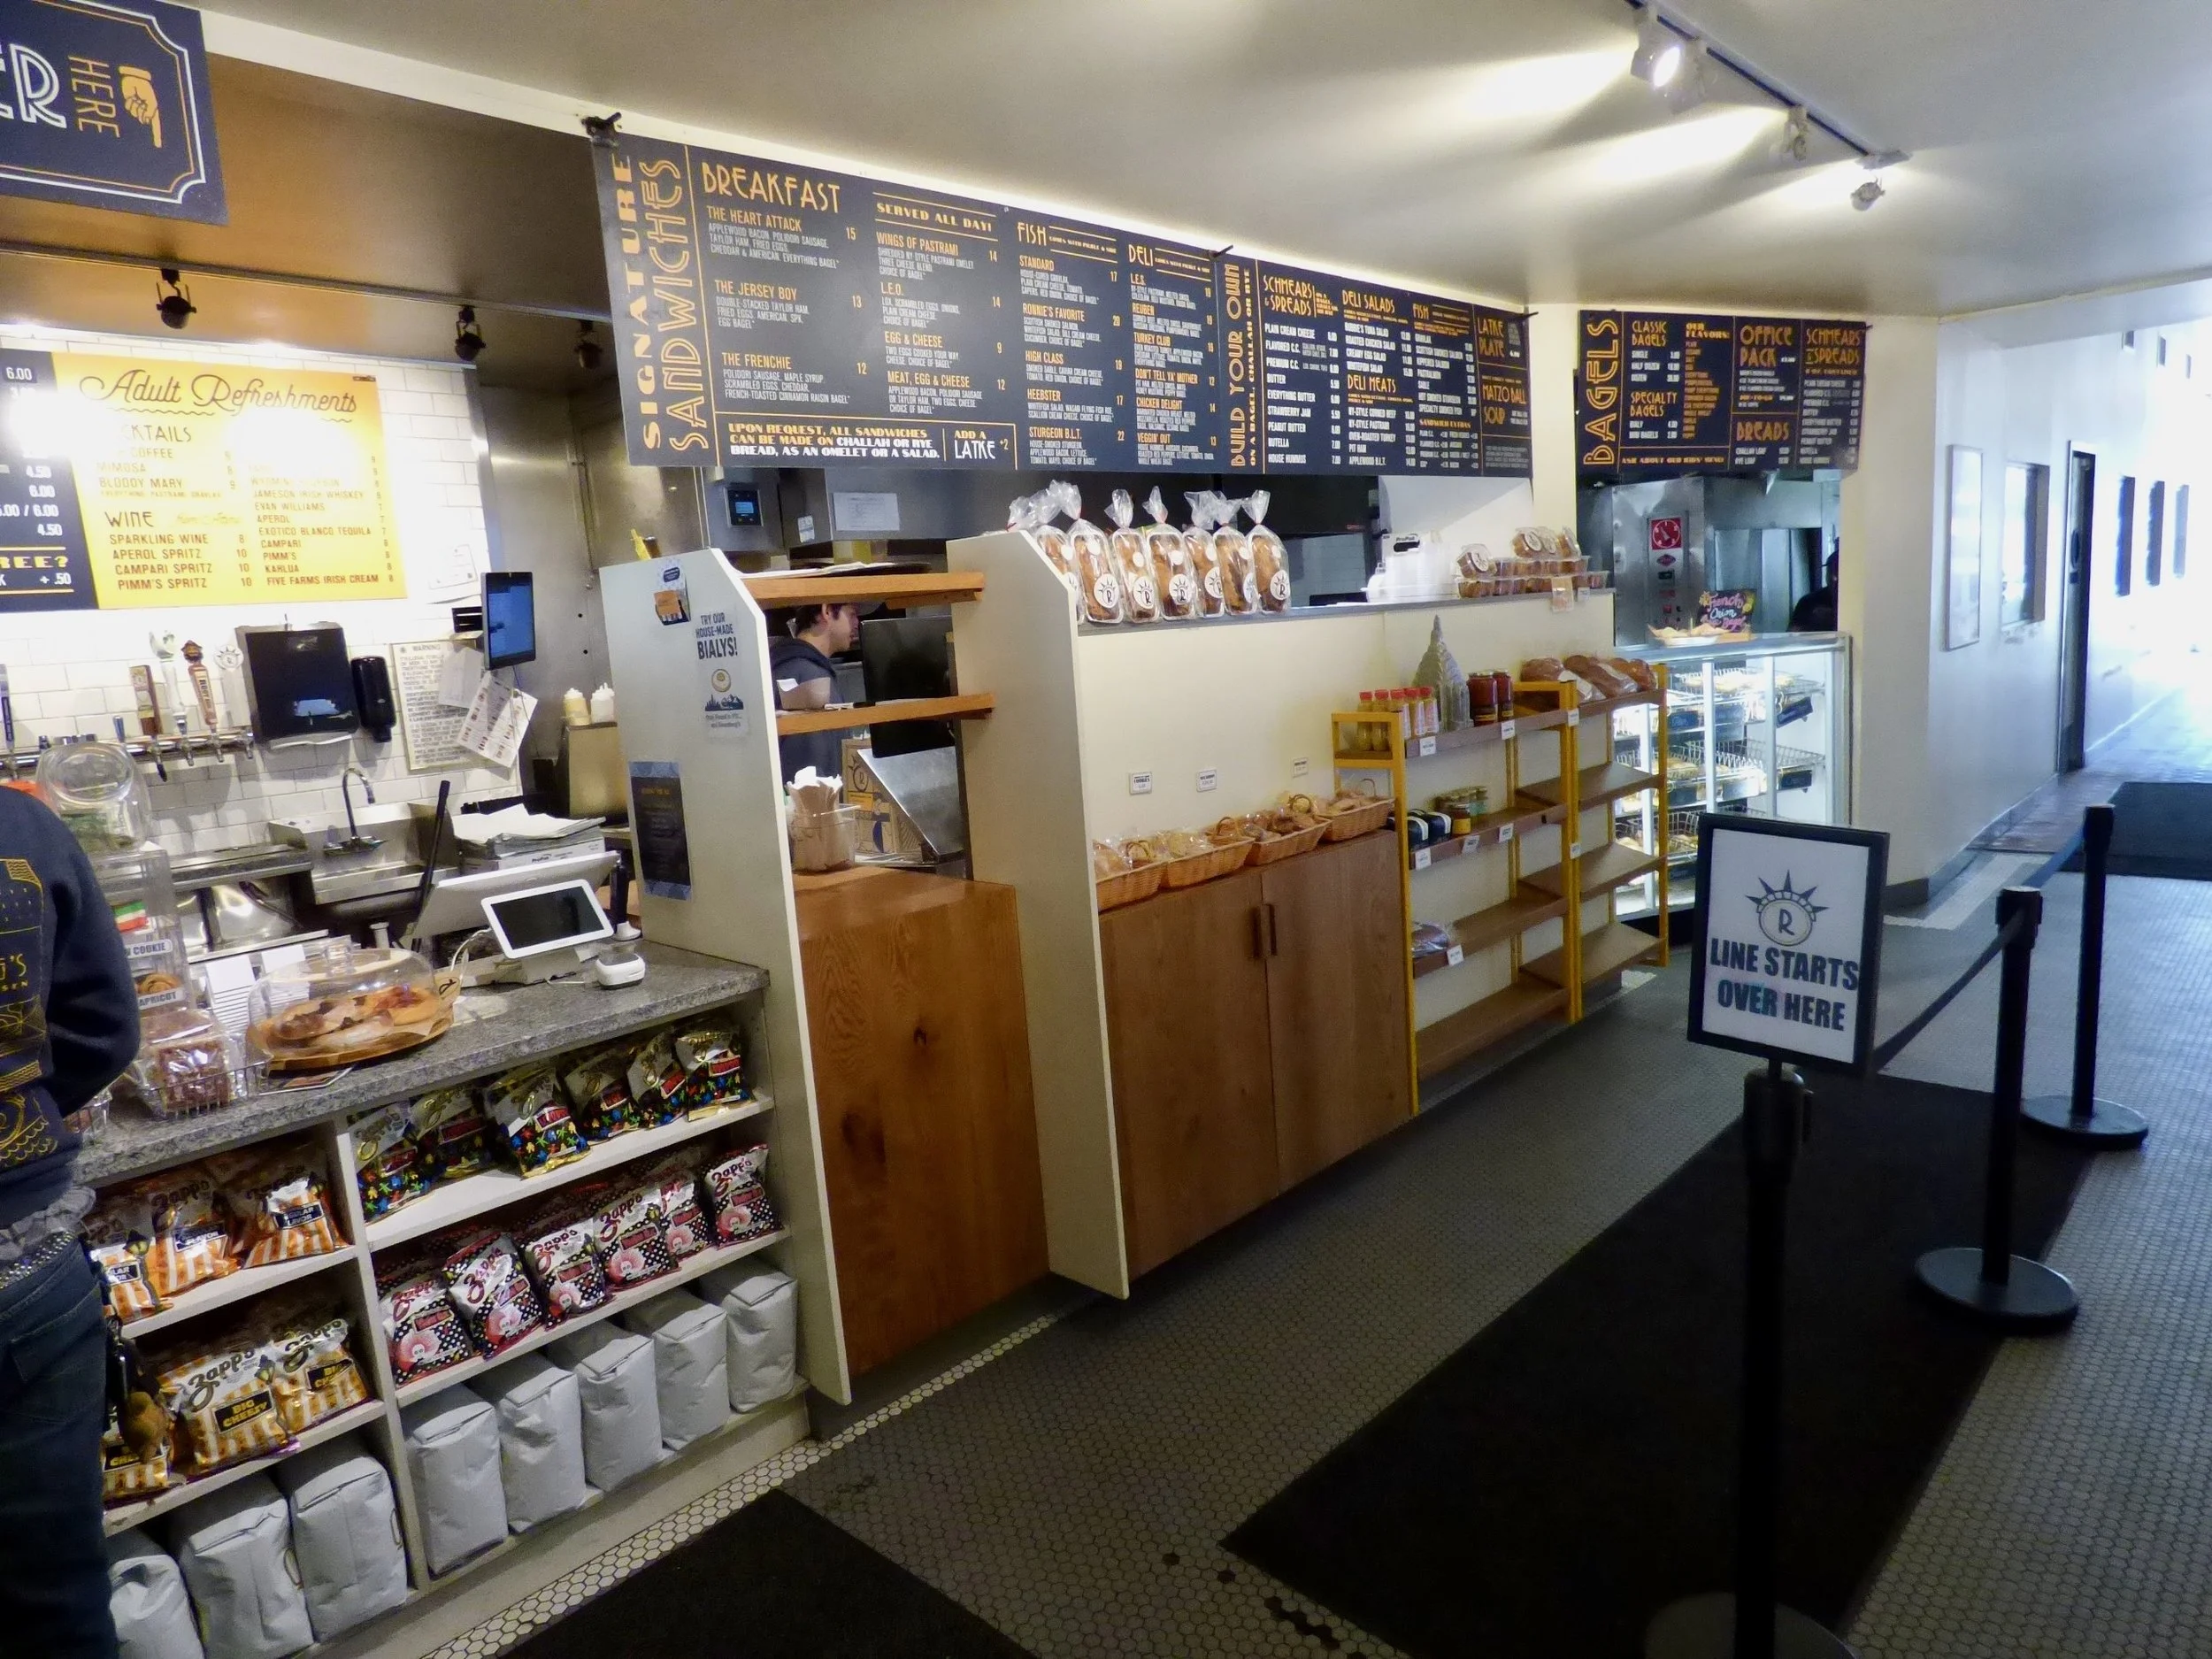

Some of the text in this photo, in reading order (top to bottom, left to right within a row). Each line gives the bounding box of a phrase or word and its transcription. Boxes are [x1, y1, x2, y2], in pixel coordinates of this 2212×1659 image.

[68, 56, 120, 138] HERE
[701, 161, 840, 213] BREAKFAST
[707, 205, 856, 241] THE HEART ATTACK 15
[877, 203, 992, 232] SERVED ALL DAY!
[1018, 221, 1047, 246] FISH
[876, 232, 998, 262] WINGS OF PASTRAMI 14
[1128, 244, 1154, 266] DELI
[1019, 255, 1118, 282] STANDARD 17
[715, 280, 863, 308] THE JERSEY BOY 13
[880, 281, 1001, 308] L.E.O. 14
[1263, 274, 1312, 299] SCHMEARS
[611, 153, 661, 449] SIGNATURE
[639, 159, 709, 451] SANDWICHES
[1271, 295, 1311, 317] SPREADS
[1341, 289, 1361, 308] DELI
[1364, 295, 1395, 314] SALADS
[1022, 303, 1054, 318] RONNIE'S
[1055, 307, 1086, 322] FAVORITE
[1112, 315, 1121, 326] 20
[1632, 320, 1667, 334] CLASSIC
[1740, 325, 1793, 346] OFFICE
[885, 331, 1002, 354] EGG & CHEESE 9
[1133, 332, 1156, 344] TURKEY
[1632, 334, 1666, 347] BAGELS
[722, 352, 867, 375] THE FRENCHIE 12
[1025, 350, 1041, 362] HIGH
[1044, 351, 1064, 365] CLASS
[1224, 264, 1247, 467] BUILD YOUR OWN
[1740, 347, 1777, 367] PACK
[6, 366, 33, 380] 6.00
[887, 371, 1005, 390] MEAT, EGG & CHEESE 12
[80, 369, 357, 416] Adult Refreshments
[1347, 374, 1396, 393] DELI MEATS
[1583, 319, 1619, 465] BAGELS
[1027, 388, 1124, 406] HEEBSTER 17
[1630, 391, 1678, 404] SPECIALTY
[1483, 406, 1506, 425] SOUP
[1630, 404, 1663, 417] BAGELS
[728, 423, 927, 438] UPON REQUEST, ALL SANDWICHES
[954, 430, 976, 439] ADD
[1029, 426, 1063, 439] STURGEON
[1118, 430, 1125, 442] 22
[1736, 421, 1790, 442] BREADS
[730, 434, 933, 449] CAN BE MADE ON CHALLAH OR RYE
[954, 439, 996, 459] LATKE
[730, 445, 941, 458] BREAD, AS AN OMELET OR A SALAD.
[150, 478, 182, 488] MARY
[33, 504, 59, 517] 6.00
[104, 511, 155, 528] WINE
[37, 524, 63, 536] 4.50
[110, 534, 174, 545] SPARKLING
[179, 534, 209, 545] WINE
[112, 548, 248, 560] APEROL SPRITZ 10
[115, 562, 250, 575] CAMPARI SPRITZ 10
[118, 577, 252, 591] PIMM'S SPRITZ 10
[267, 576, 287, 586] FIVE
[289, 575, 320, 585] FARMS
[349, 574, 379, 583] CREAM
[701, 612, 726, 626] TRY OUR
[695, 624, 734, 639] HOUSE-MADE
[697, 637, 738, 660] BIALYS!
[1778, 908, 1795, 936] R
[133, 942, 166, 956] COOKIE
[1710, 938, 1859, 991] LINE STARTS
[139, 991, 177, 1006] APRICOT
[1717, 979, 1846, 1032] OVER HERE
